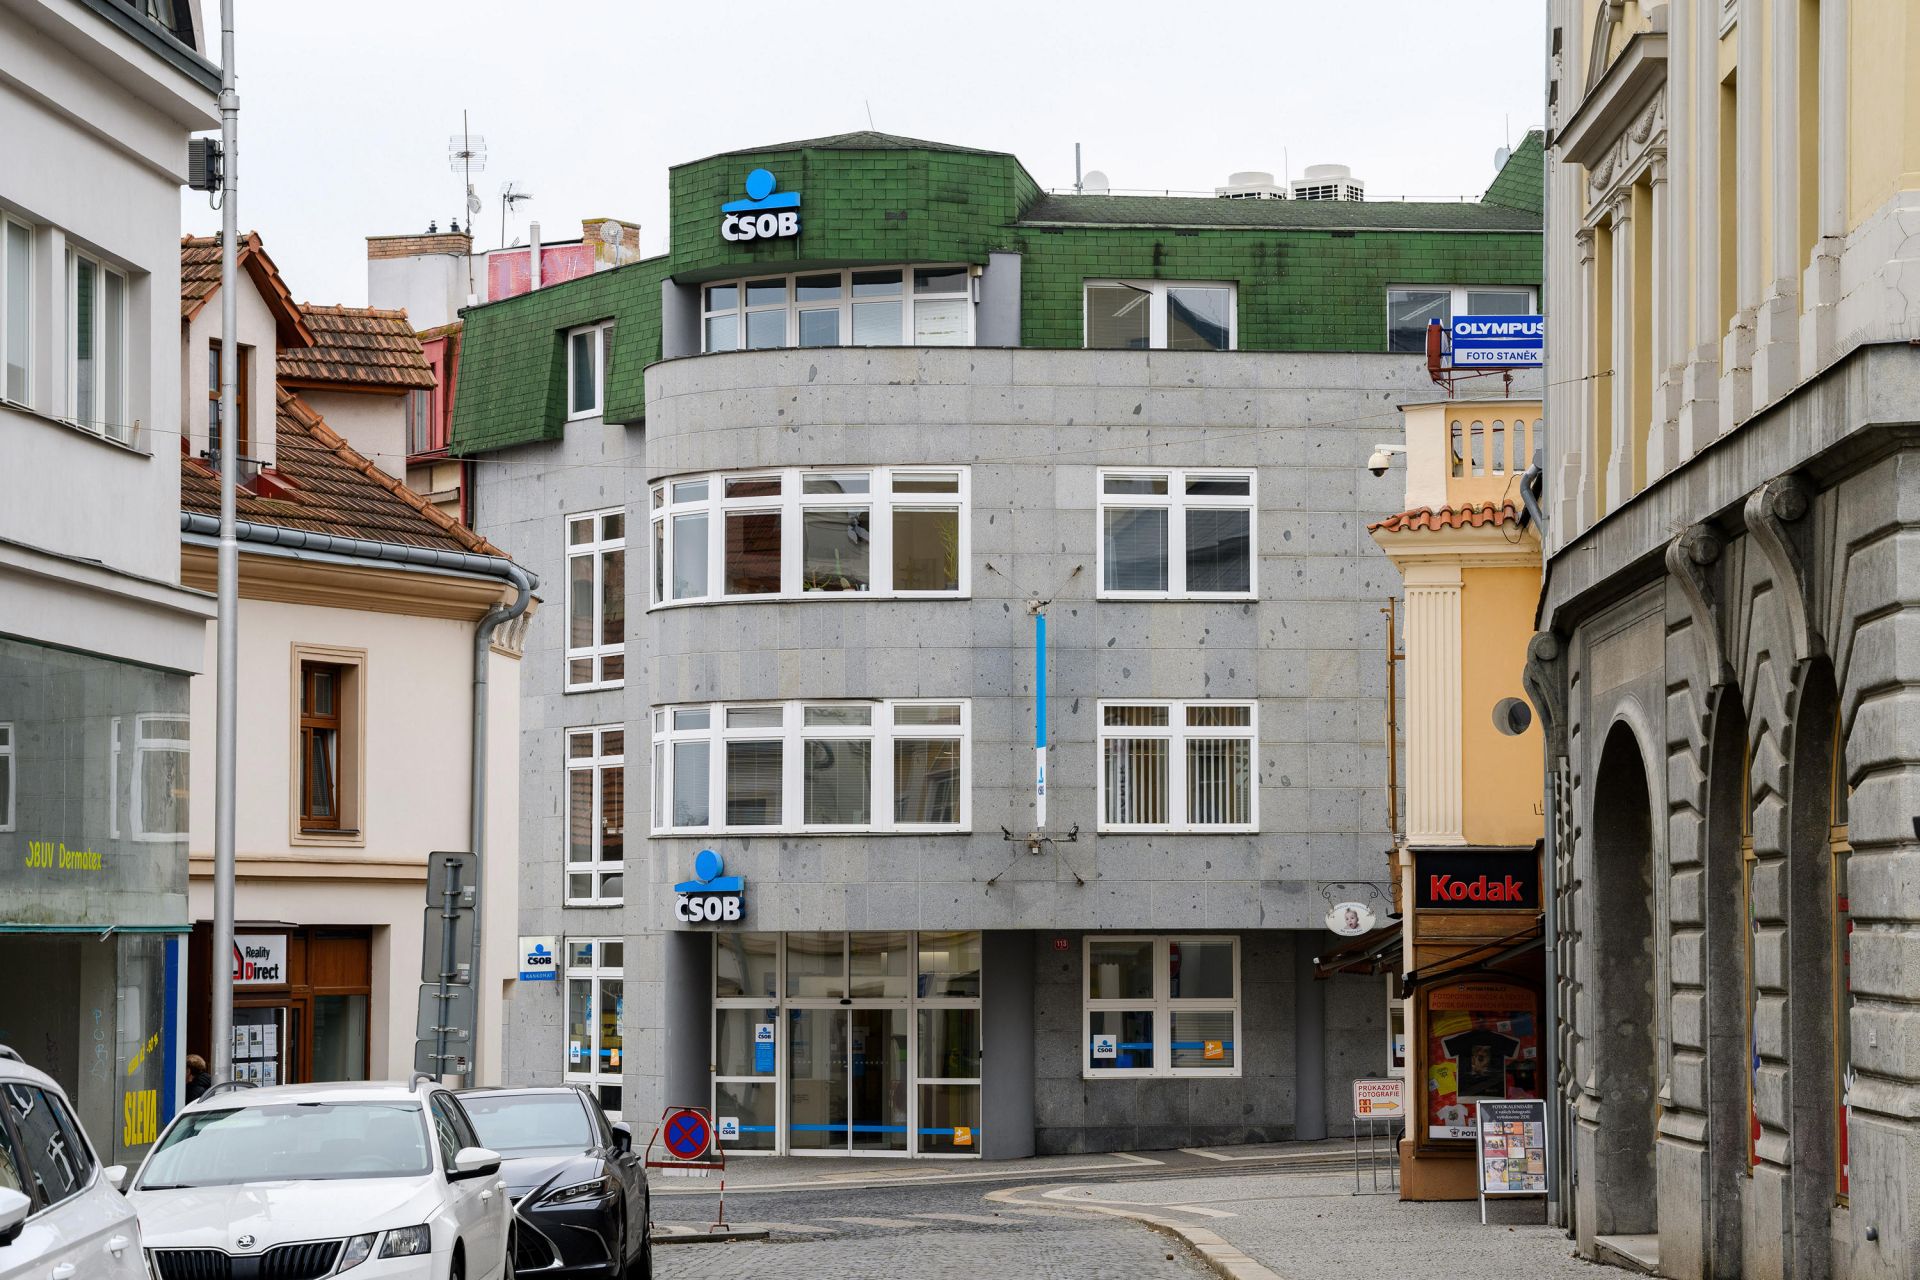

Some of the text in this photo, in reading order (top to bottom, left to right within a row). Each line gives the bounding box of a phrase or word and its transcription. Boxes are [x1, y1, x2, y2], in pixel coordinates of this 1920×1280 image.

[721, 212, 799, 241] ČSOB
[1466, 350, 1538, 361] FOTO STANĚK
[1430, 874, 1524, 901] Kodak
[674, 894, 741, 922] ČSOB
[245, 946, 271, 961] Reality
[527, 956, 552, 965] ČSOB
[245, 962, 279, 980] Direct
[123, 1089, 157, 1148] SLEVA
